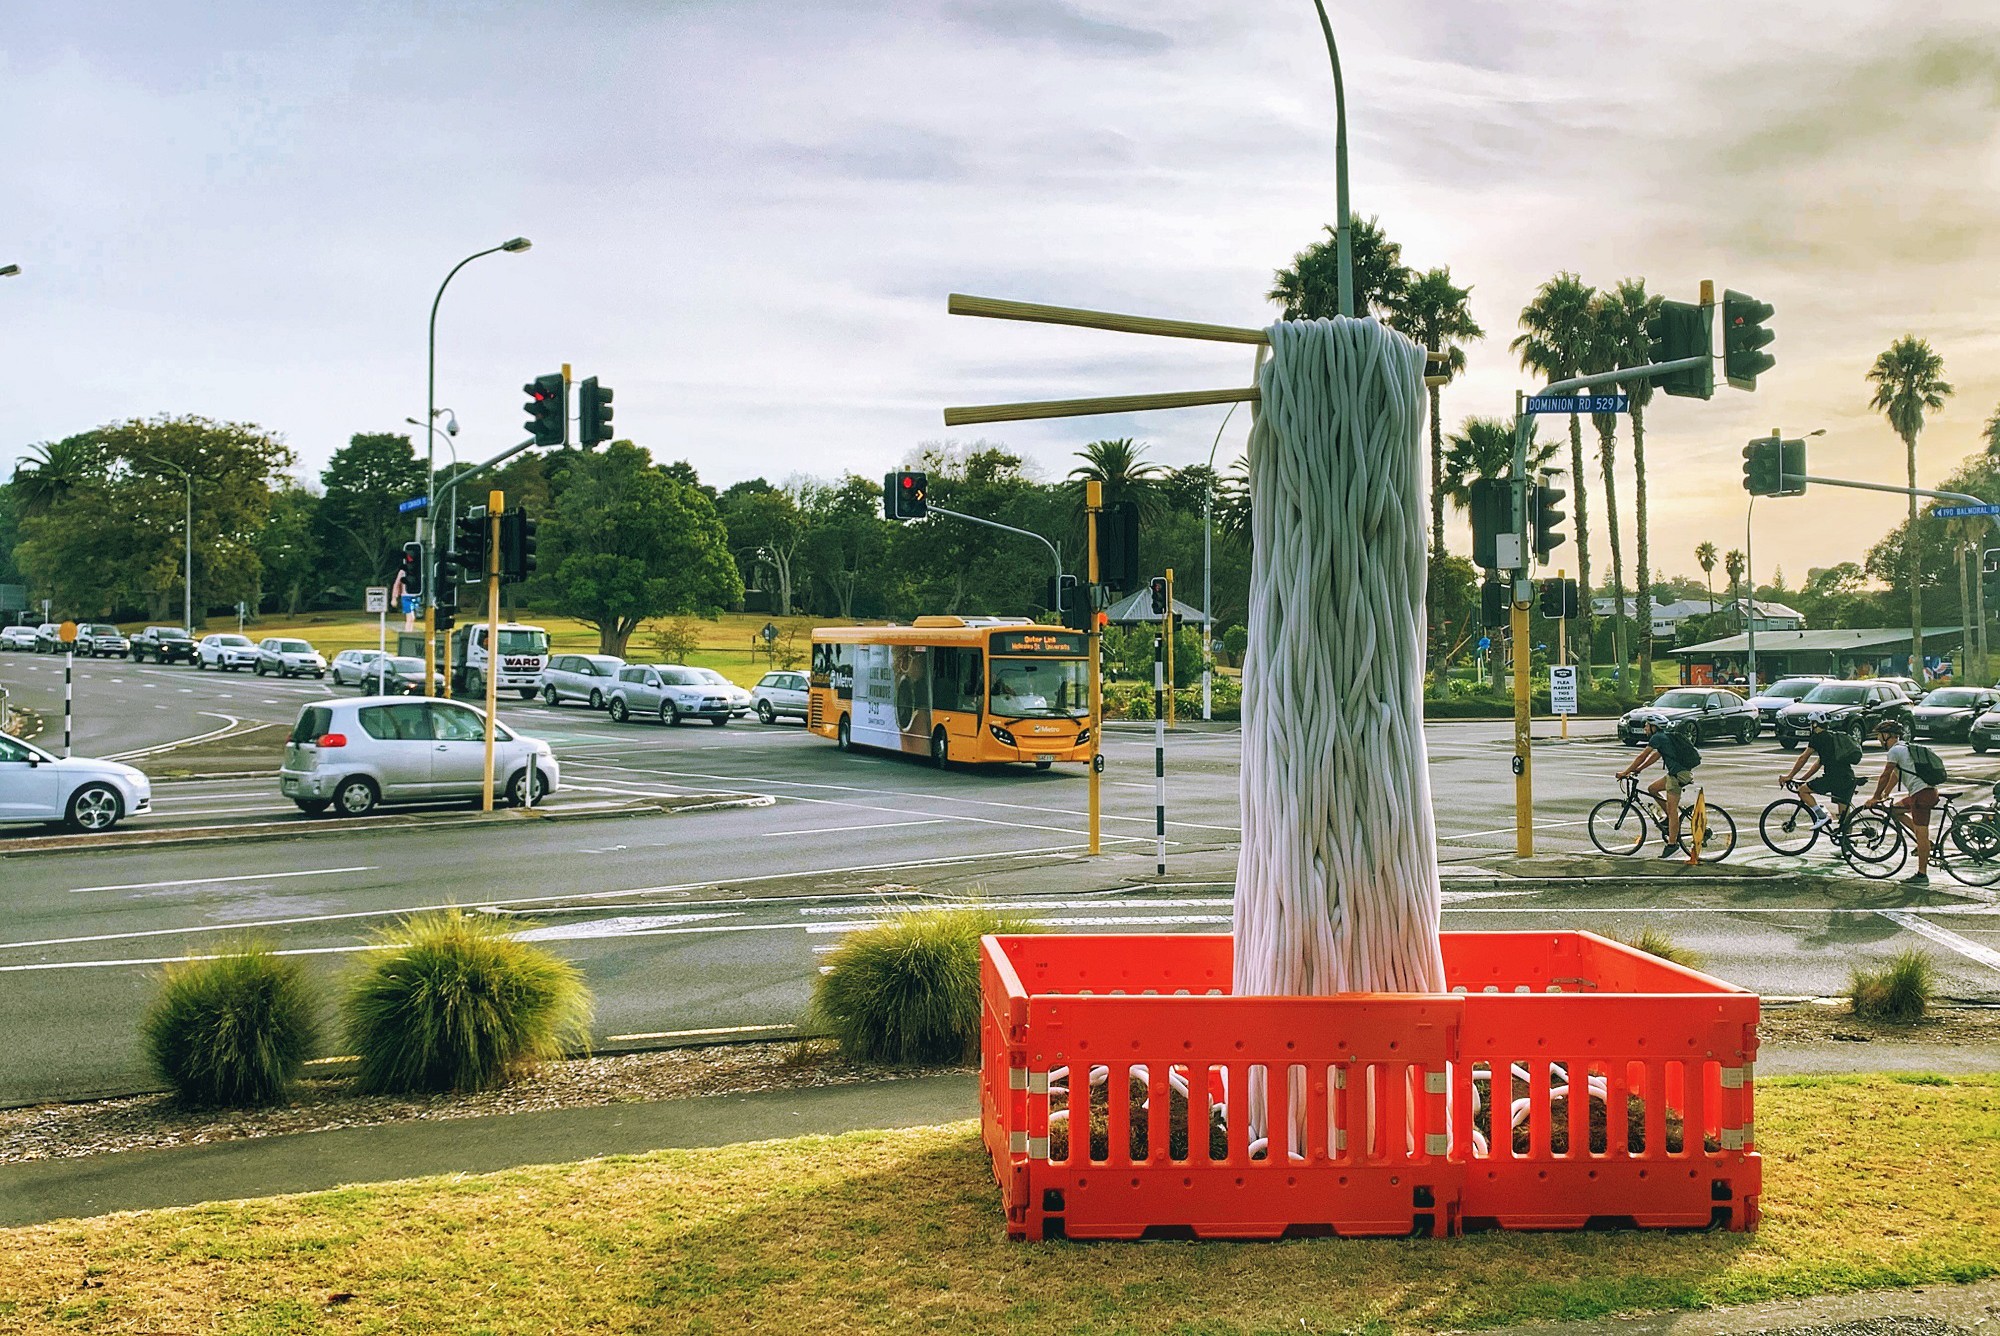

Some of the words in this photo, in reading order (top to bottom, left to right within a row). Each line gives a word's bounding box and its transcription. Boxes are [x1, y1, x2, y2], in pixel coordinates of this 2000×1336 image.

[1528, 398, 1573, 411] DOMINION
[1578, 398, 1591, 410] RD
[1596, 397, 1614, 410] 529
[1956, 506, 1988, 515] BALMORAL
[1991, 505, 2000, 513] RD
[1024, 635, 1042, 644] Outer
[836, 671, 853, 688] Metro
